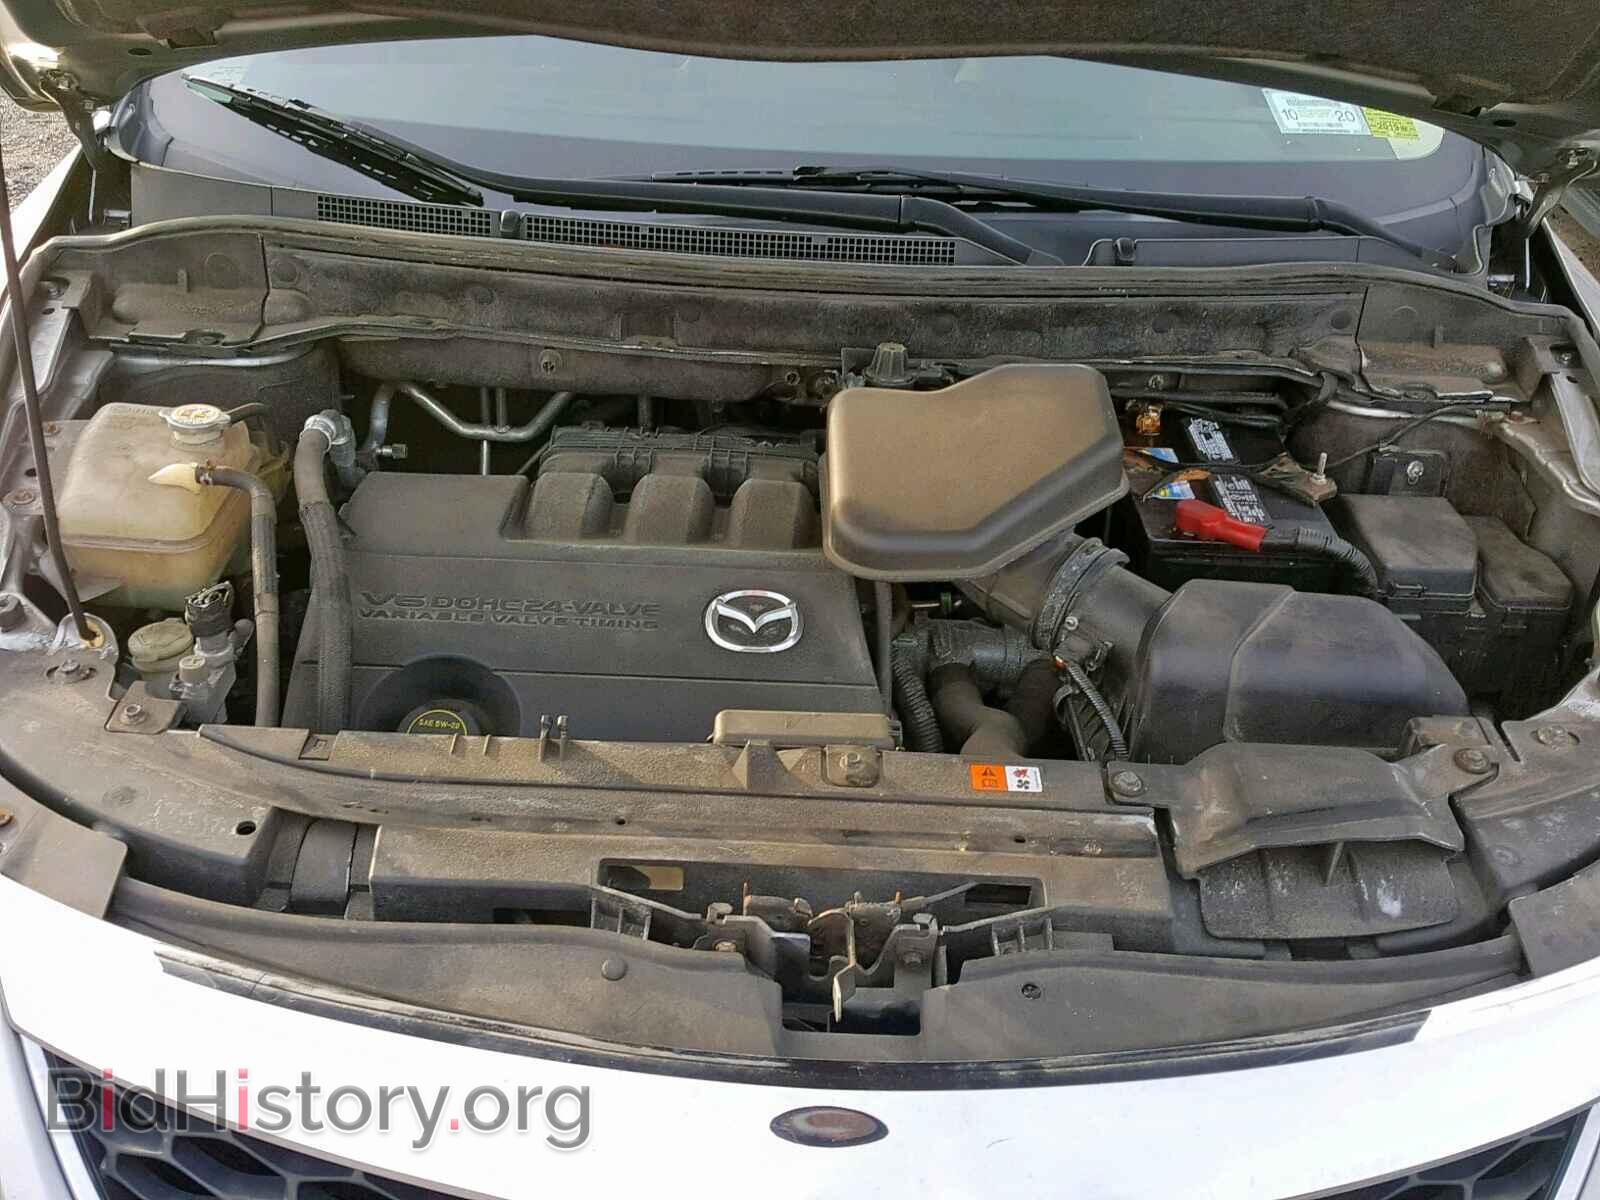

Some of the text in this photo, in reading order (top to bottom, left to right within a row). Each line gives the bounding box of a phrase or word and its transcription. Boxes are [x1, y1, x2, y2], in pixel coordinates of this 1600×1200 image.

[1282, 108, 1298, 121] 10
[1334, 110, 1355, 122] 20
[357, 607, 660, 631] VARIABLE VALVE TIMING
